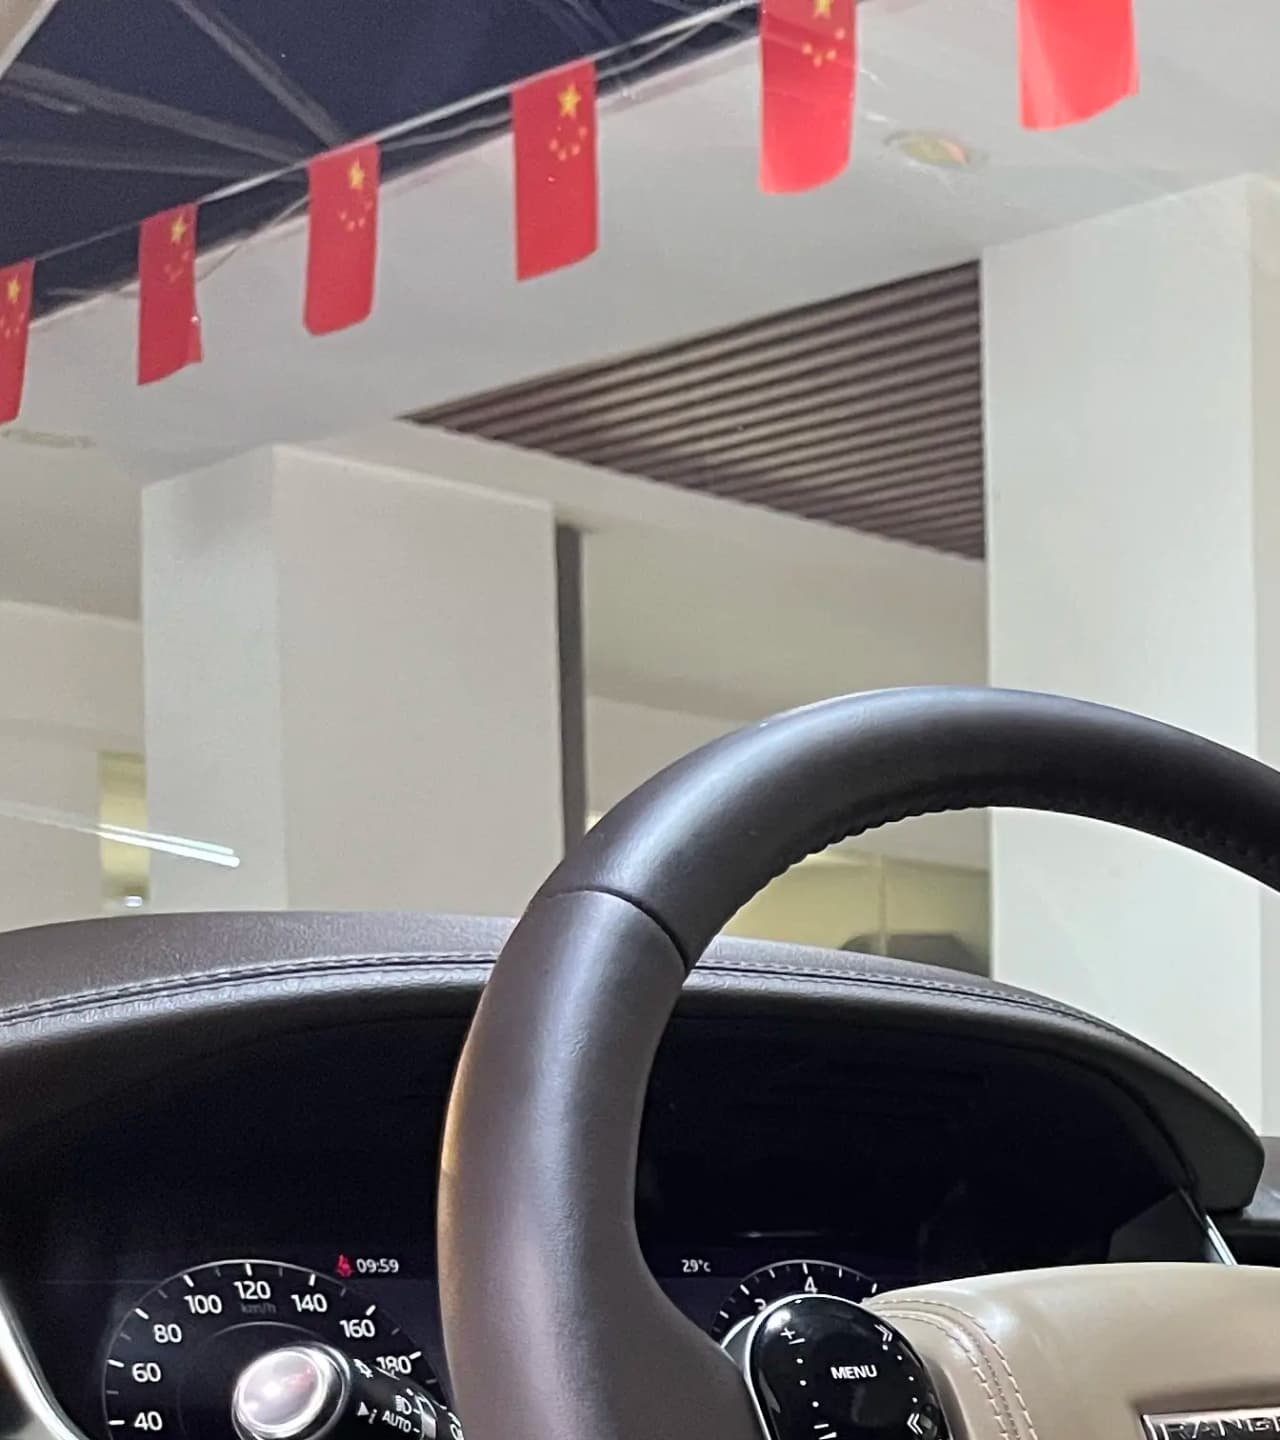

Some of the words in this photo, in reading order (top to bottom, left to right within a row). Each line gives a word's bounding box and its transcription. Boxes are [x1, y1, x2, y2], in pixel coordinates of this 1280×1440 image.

[356, 1258, 399, 1273] 09:59
[233, 1280, 271, 1300] 120
[184, 1294, 222, 1314] 100
[240, 1302, 277, 1314] km/h
[291, 1293, 328, 1313] 140
[153, 1324, 183, 1343] 80
[339, 1319, 376, 1338] 160
[131, 1363, 162, 1383] 60
[830, 1364, 878, 1380] MENU
[133, 1412, 163, 1431] 40
[382, 1410, 412, 1433] AUTO
